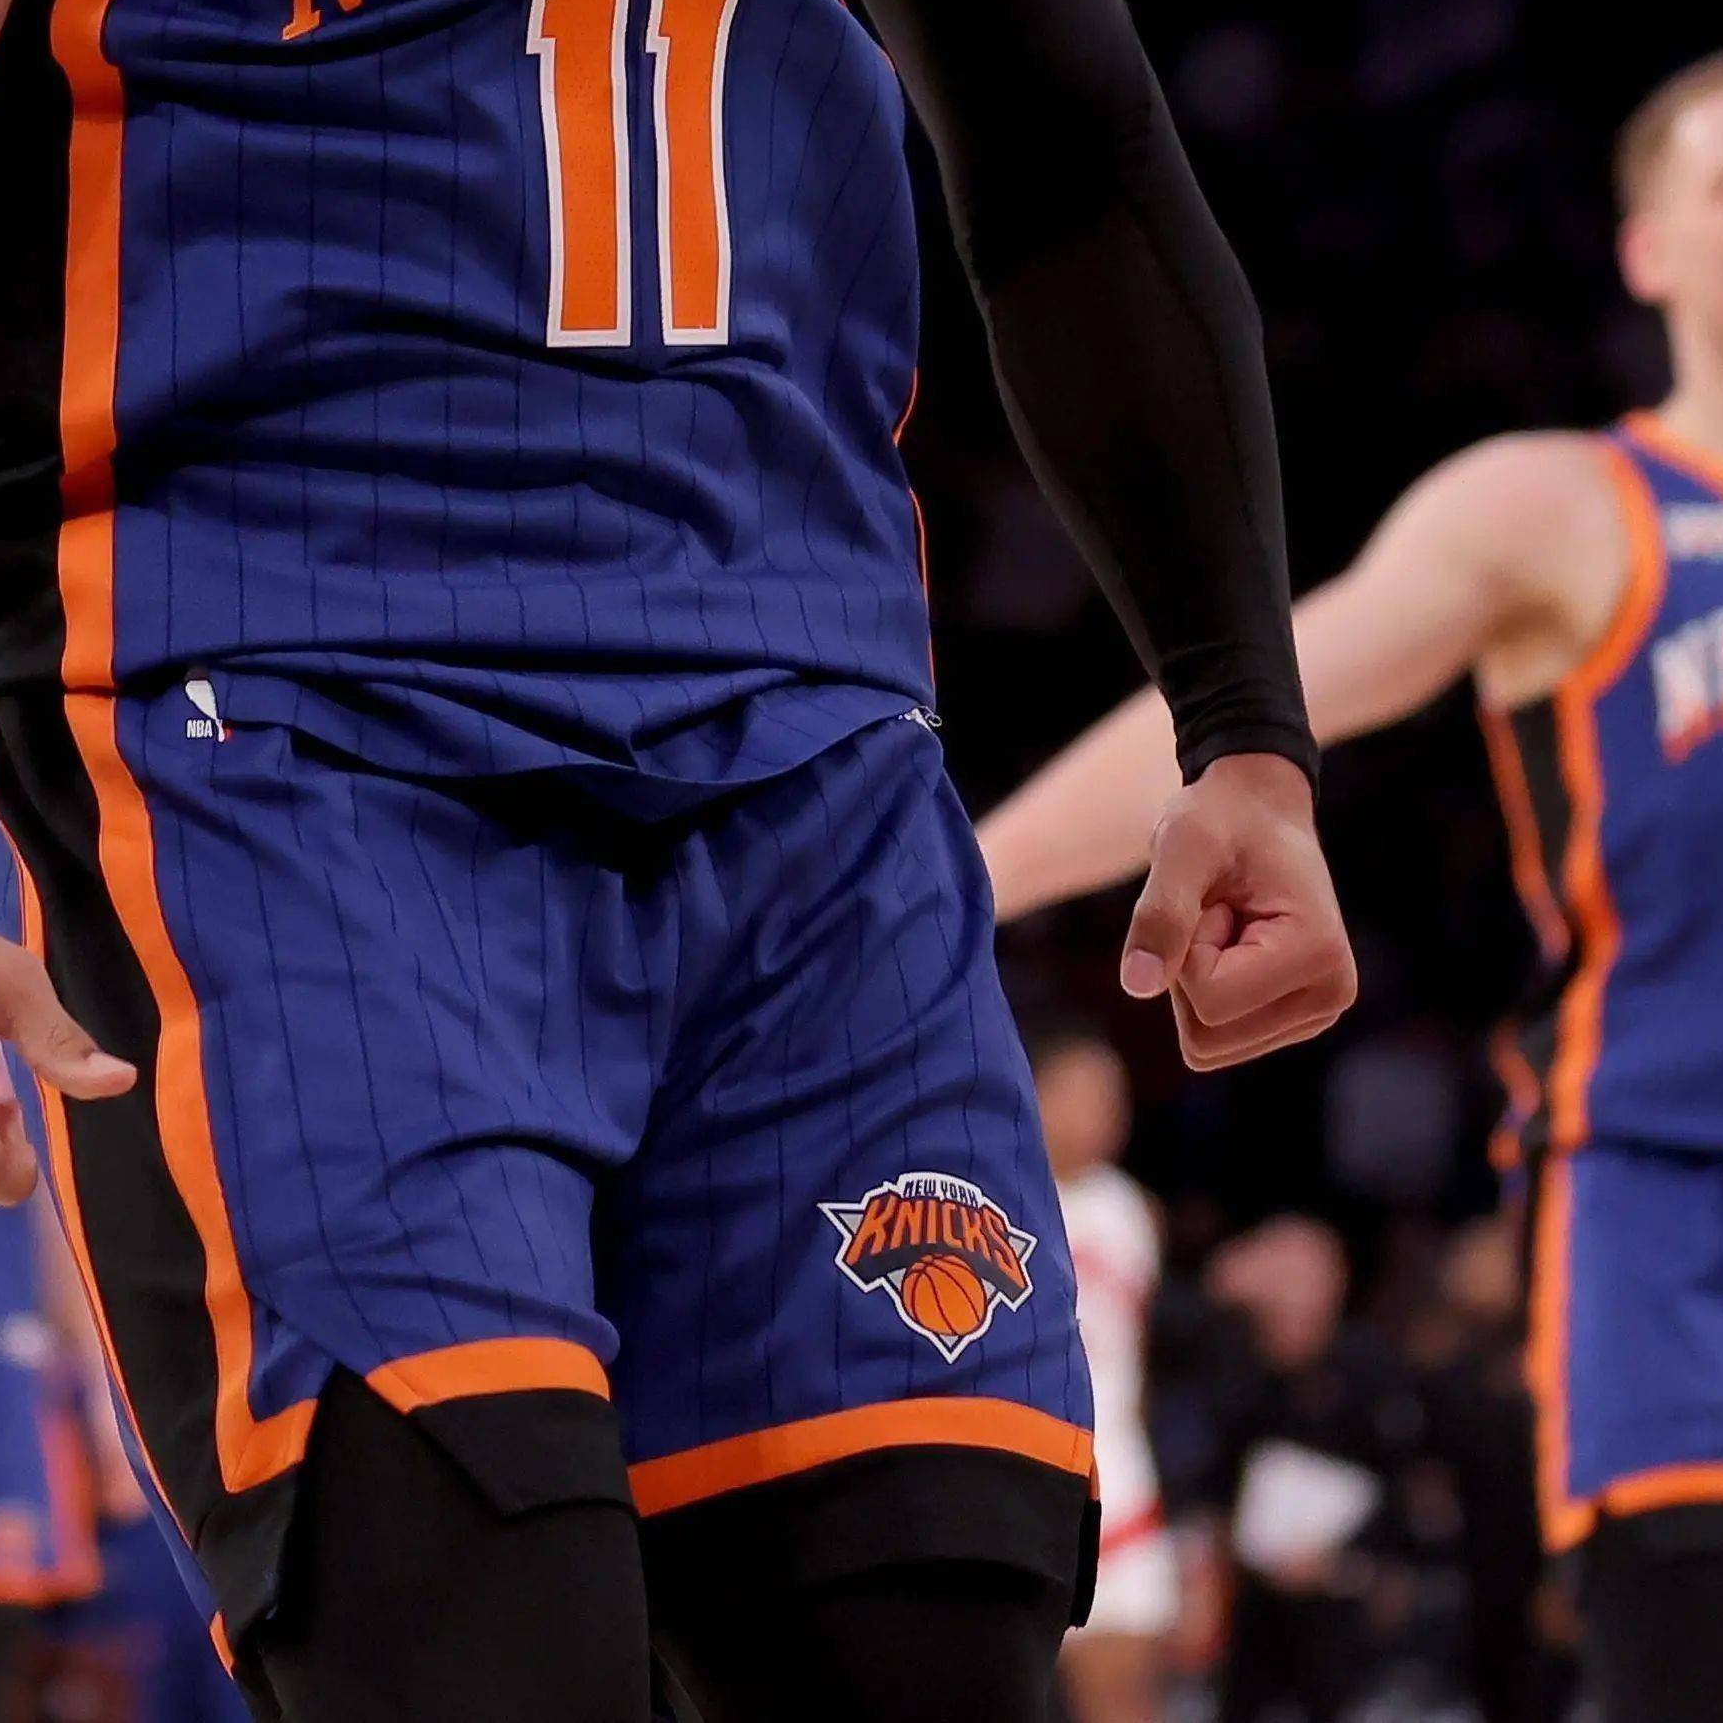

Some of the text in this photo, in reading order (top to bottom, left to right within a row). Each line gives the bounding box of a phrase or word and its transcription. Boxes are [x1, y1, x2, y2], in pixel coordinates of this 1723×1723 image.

[186, 719, 213, 738] NBA
[902, 1179, 978, 1208] NEW YORK
[845, 1191, 1027, 1289] KNICKS
